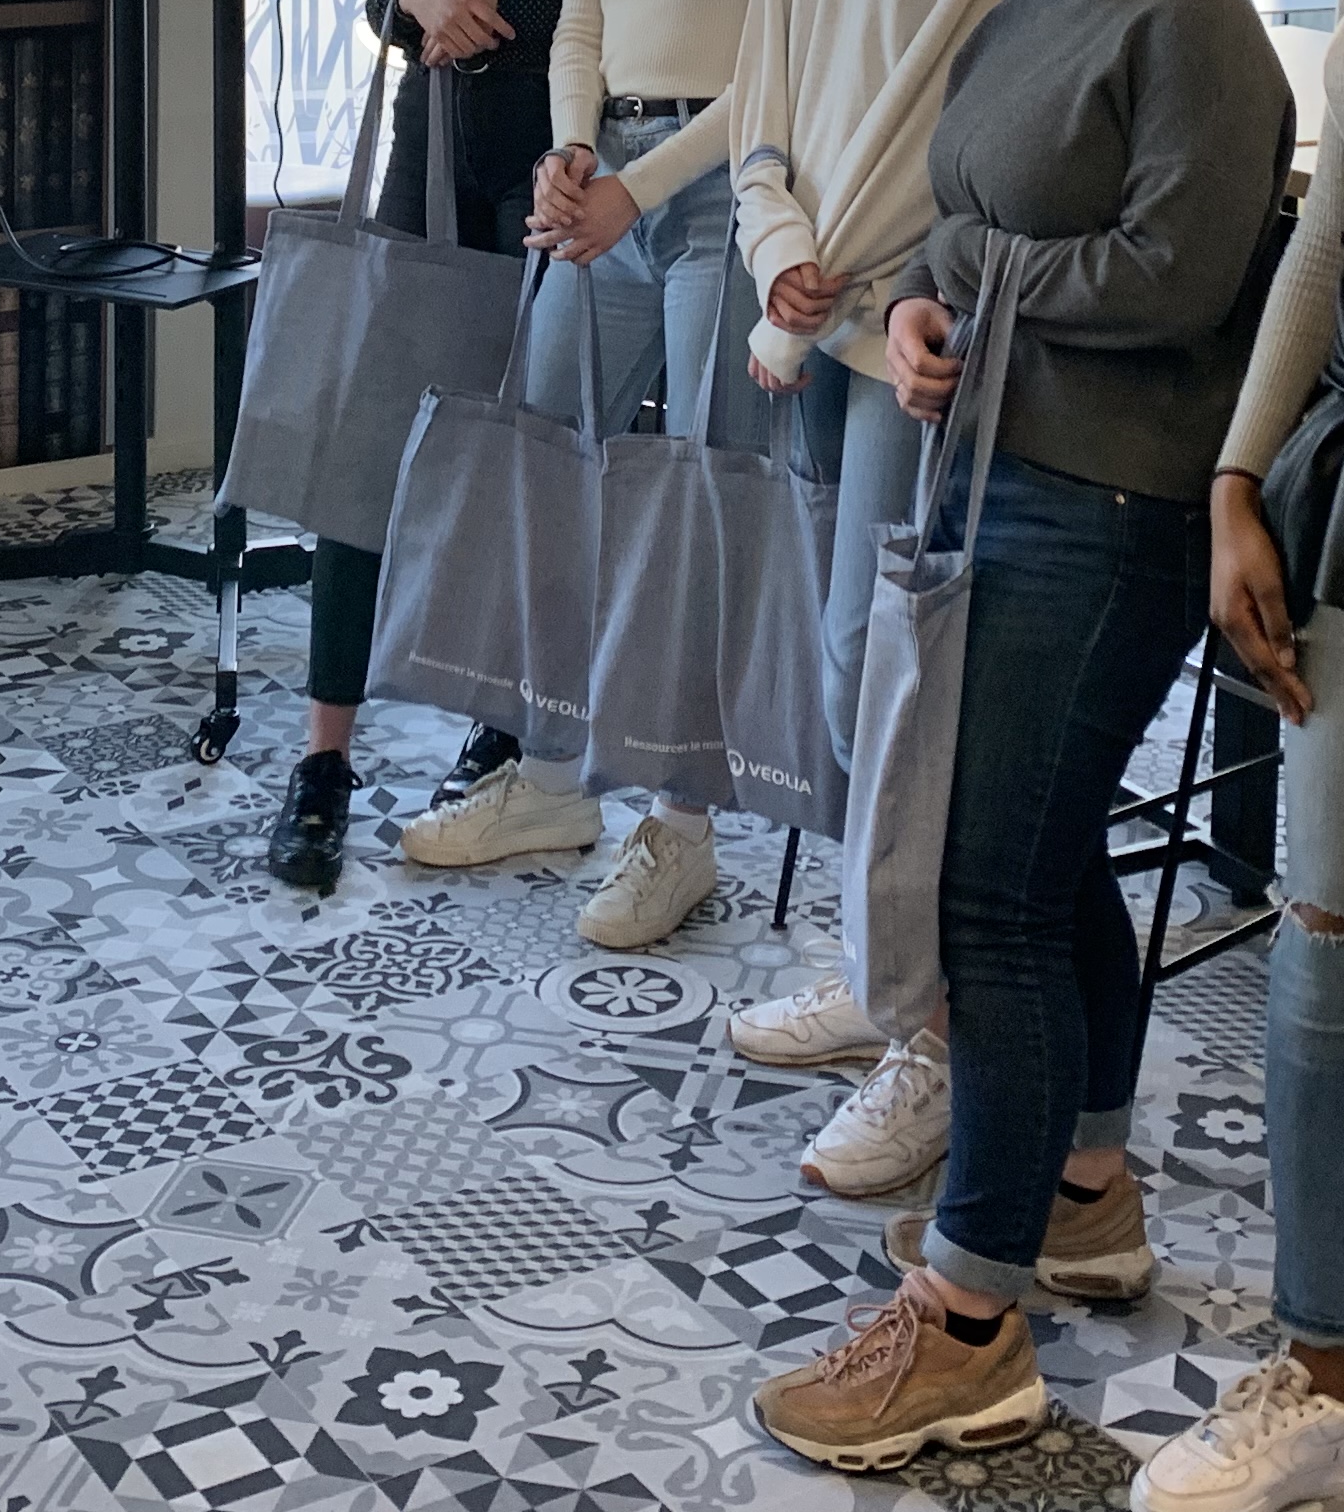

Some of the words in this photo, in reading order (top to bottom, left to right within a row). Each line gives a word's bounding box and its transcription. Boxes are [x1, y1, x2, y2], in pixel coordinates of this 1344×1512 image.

[408, 649, 466, 675] Ressourcer
[467, 666, 475, 678] le
[624, 735, 688, 754] Ressourcer
[690, 740, 700, 752] le
[748, 759, 813, 796] VEOLIA
